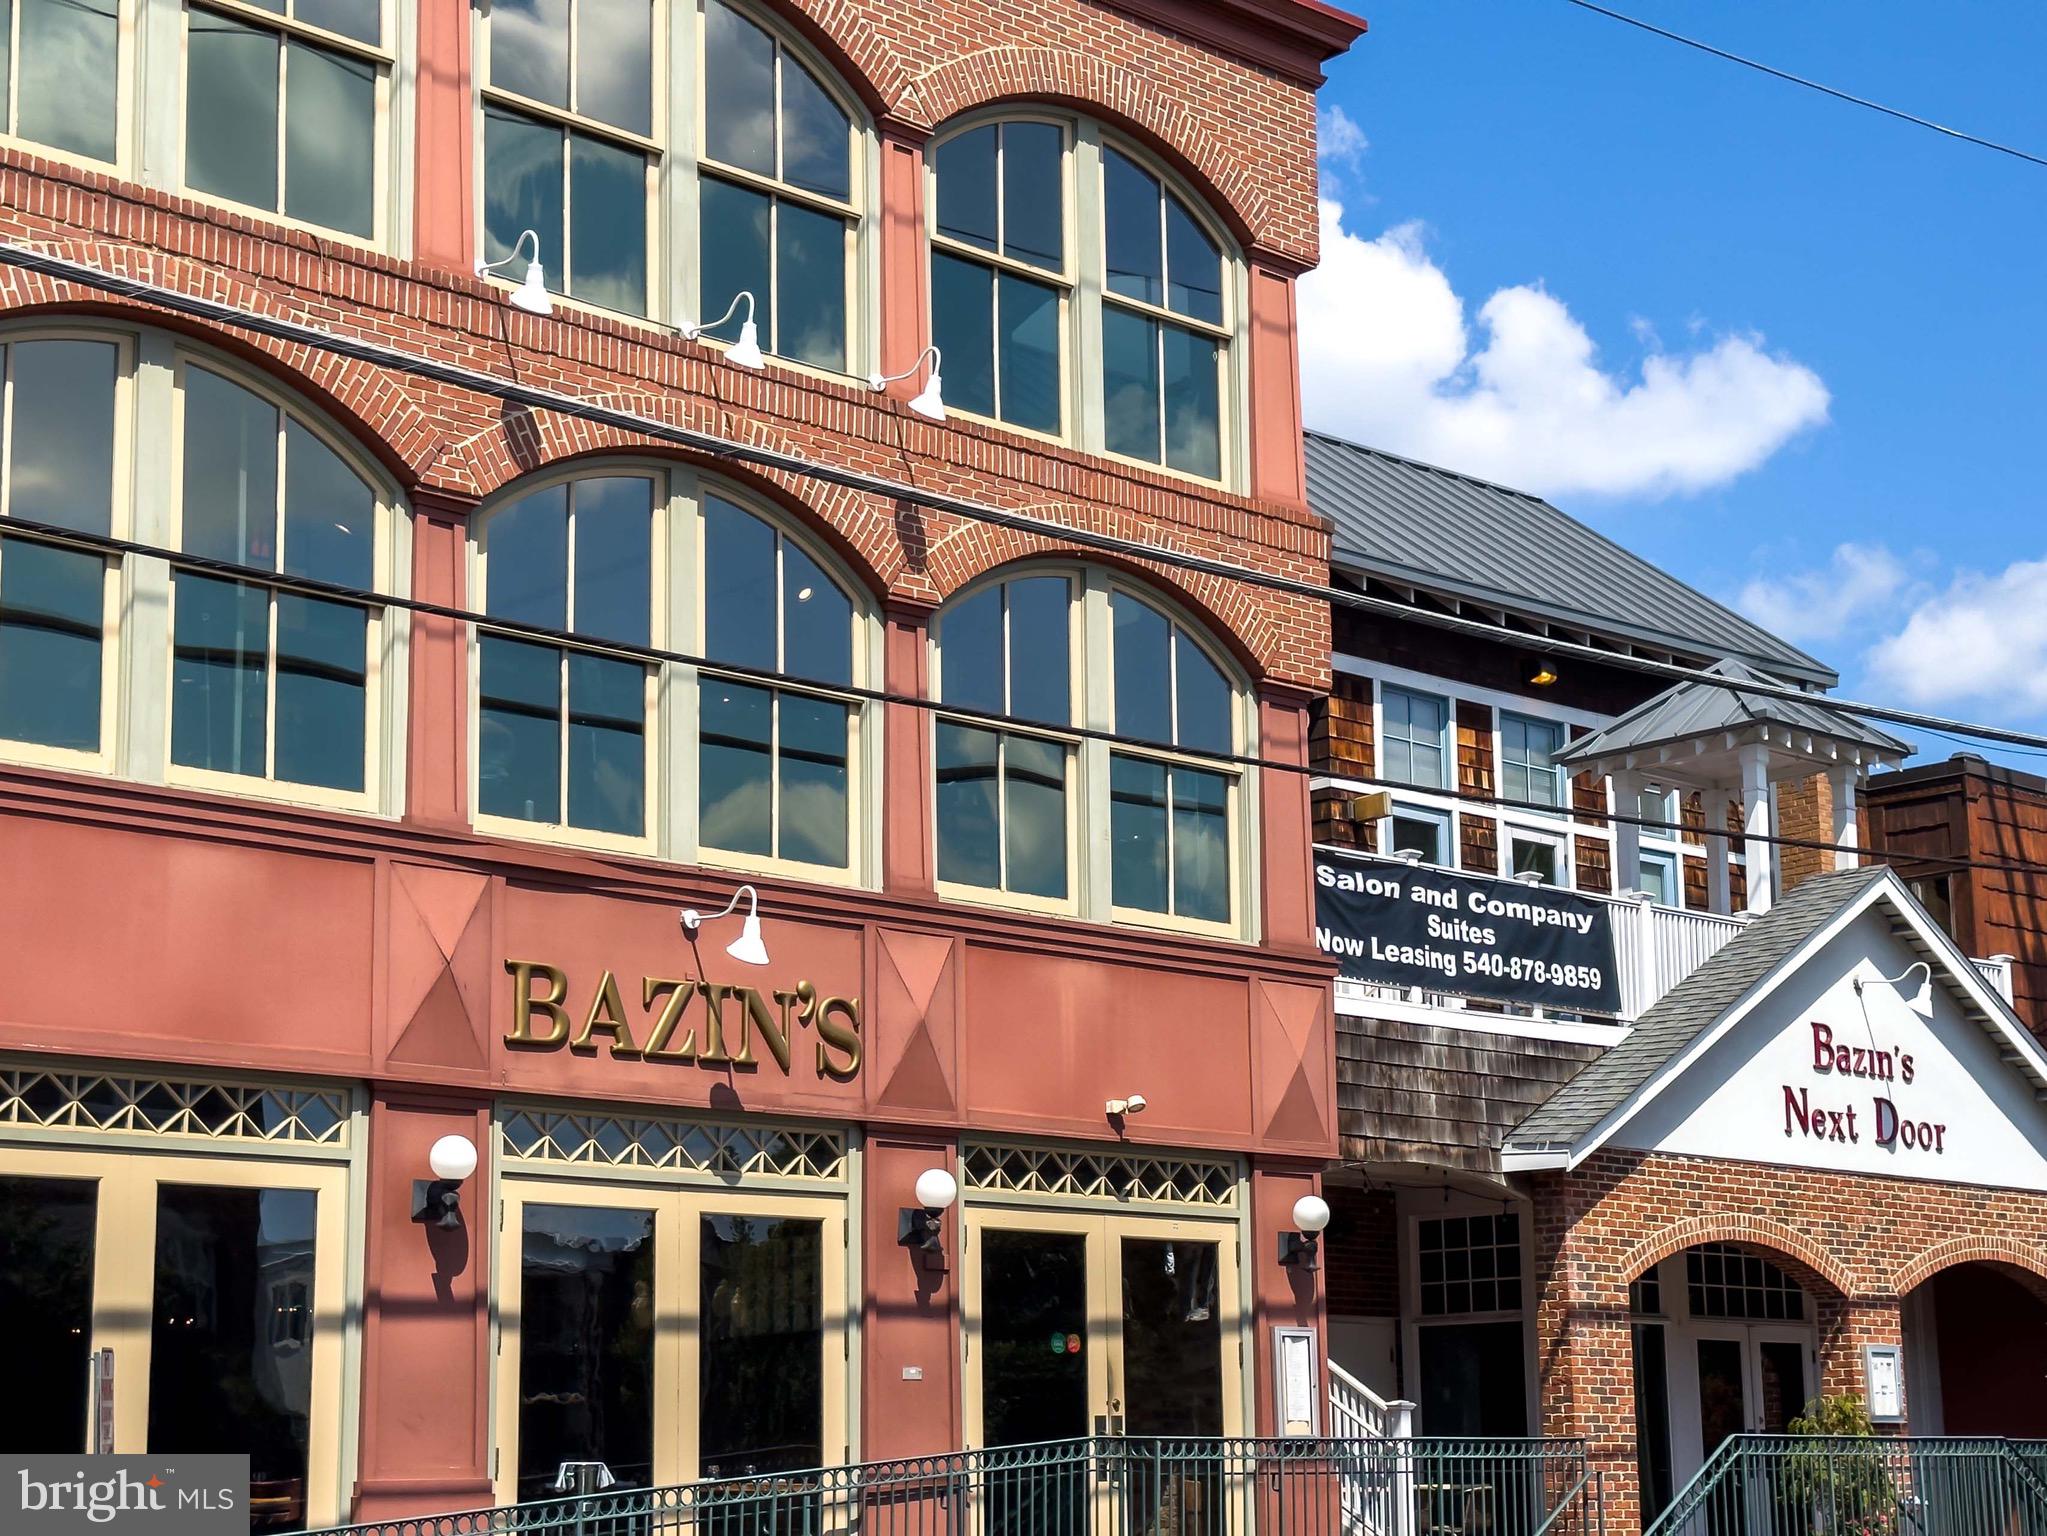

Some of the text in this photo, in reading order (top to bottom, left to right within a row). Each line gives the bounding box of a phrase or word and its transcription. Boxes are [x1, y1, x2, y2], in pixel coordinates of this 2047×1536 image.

[1316, 864, 1593, 935] Salon and Company
[1427, 914, 1496, 946] Suites
[1315, 926, 1601, 991] Now Leasing 540-878-9859
[504, 958, 862, 1081] BAZIN'S
[1810, 1021, 1914, 1083] Bazin's
[1782, 1085, 1947, 1153] Next Door
